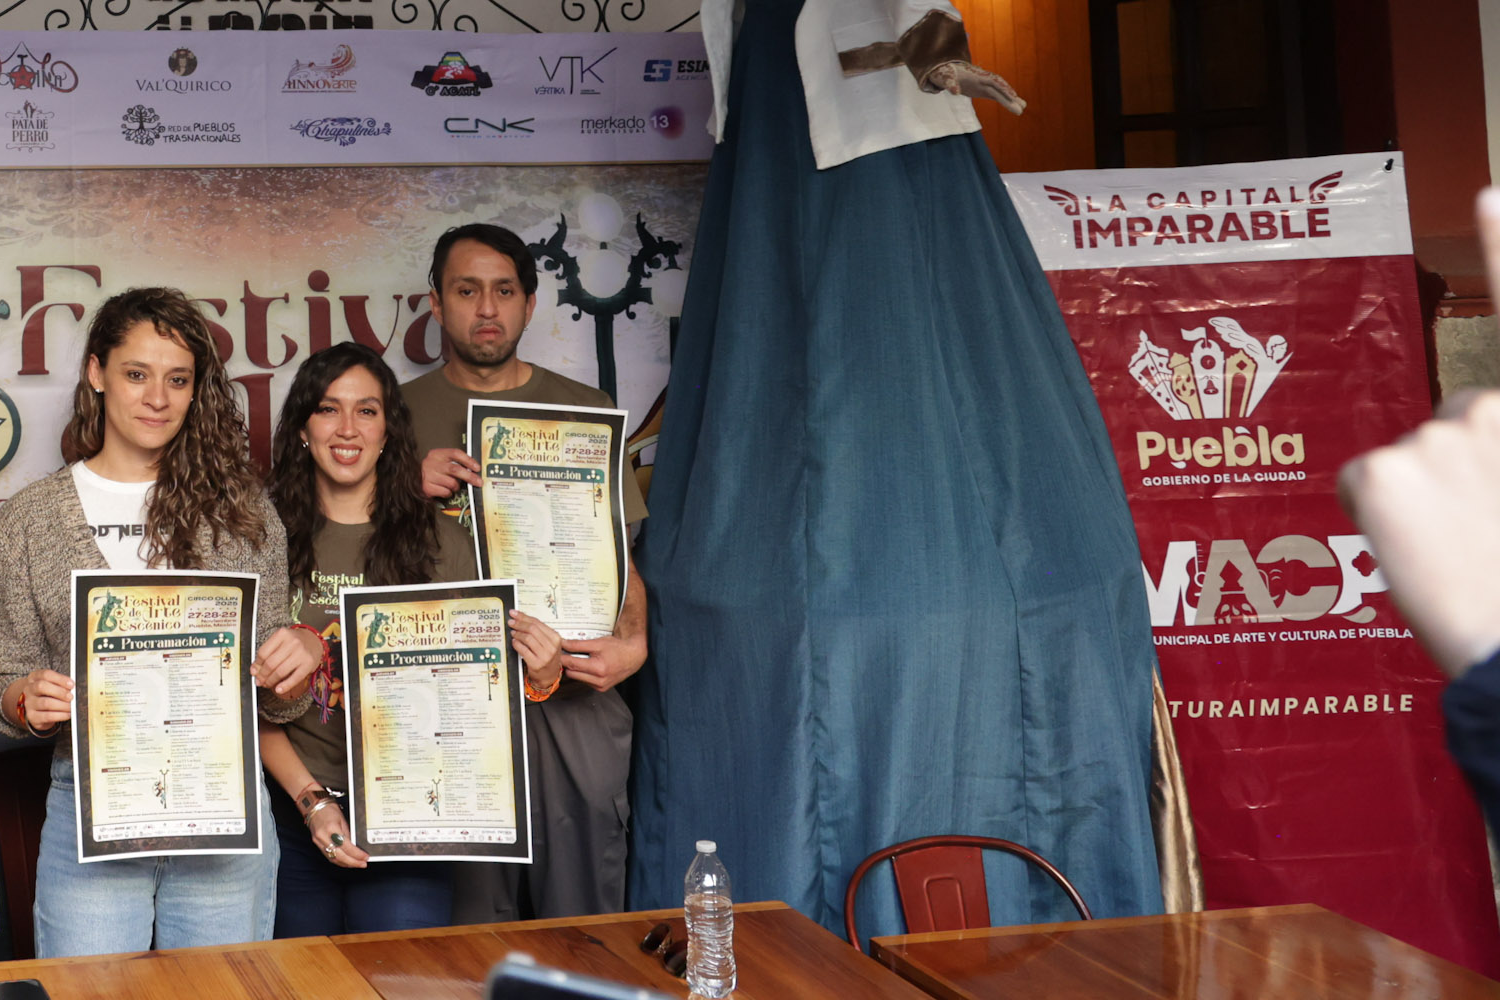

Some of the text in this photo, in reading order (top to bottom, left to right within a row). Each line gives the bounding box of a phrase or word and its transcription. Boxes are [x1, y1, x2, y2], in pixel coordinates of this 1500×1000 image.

[539, 47, 617, 95] VTK
[12, 118, 49, 129] PATA DE
[193, 122, 236, 133] PUEBLOS
[444, 117, 535, 133] CNK
[581, 115, 669, 129] merkado 13
[12, 130, 49, 142] PERRO
[162, 133, 242, 143] TRASNACIONALES
[1087, 186, 1301, 214] LA CAPITAL
[1073, 207, 1332, 250] IMPARABLE
[512, 426, 559, 441] Festival
[516, 440, 526, 448] de
[1136, 426, 1307, 471] Puebla
[509, 465, 582, 481] Programación
[1142, 470, 1307, 487] GOBIERNO DE LA CIUDAD
[311, 570, 364, 585] Festival
[1141, 535, 1390, 627] MACP
[124, 594, 180, 608] Festival
[129, 608, 141, 617] de
[391, 609, 444, 623] Festival
[395, 624, 408, 633] de
[121, 635, 207, 651] Programación
[1152, 628, 1414, 646] UNICIPAL DE ARTE Y CULTURA DE PUEBLA
[390, 651, 474, 667] Programación
[1169, 693, 1413, 718] TURAIMPARABLE
